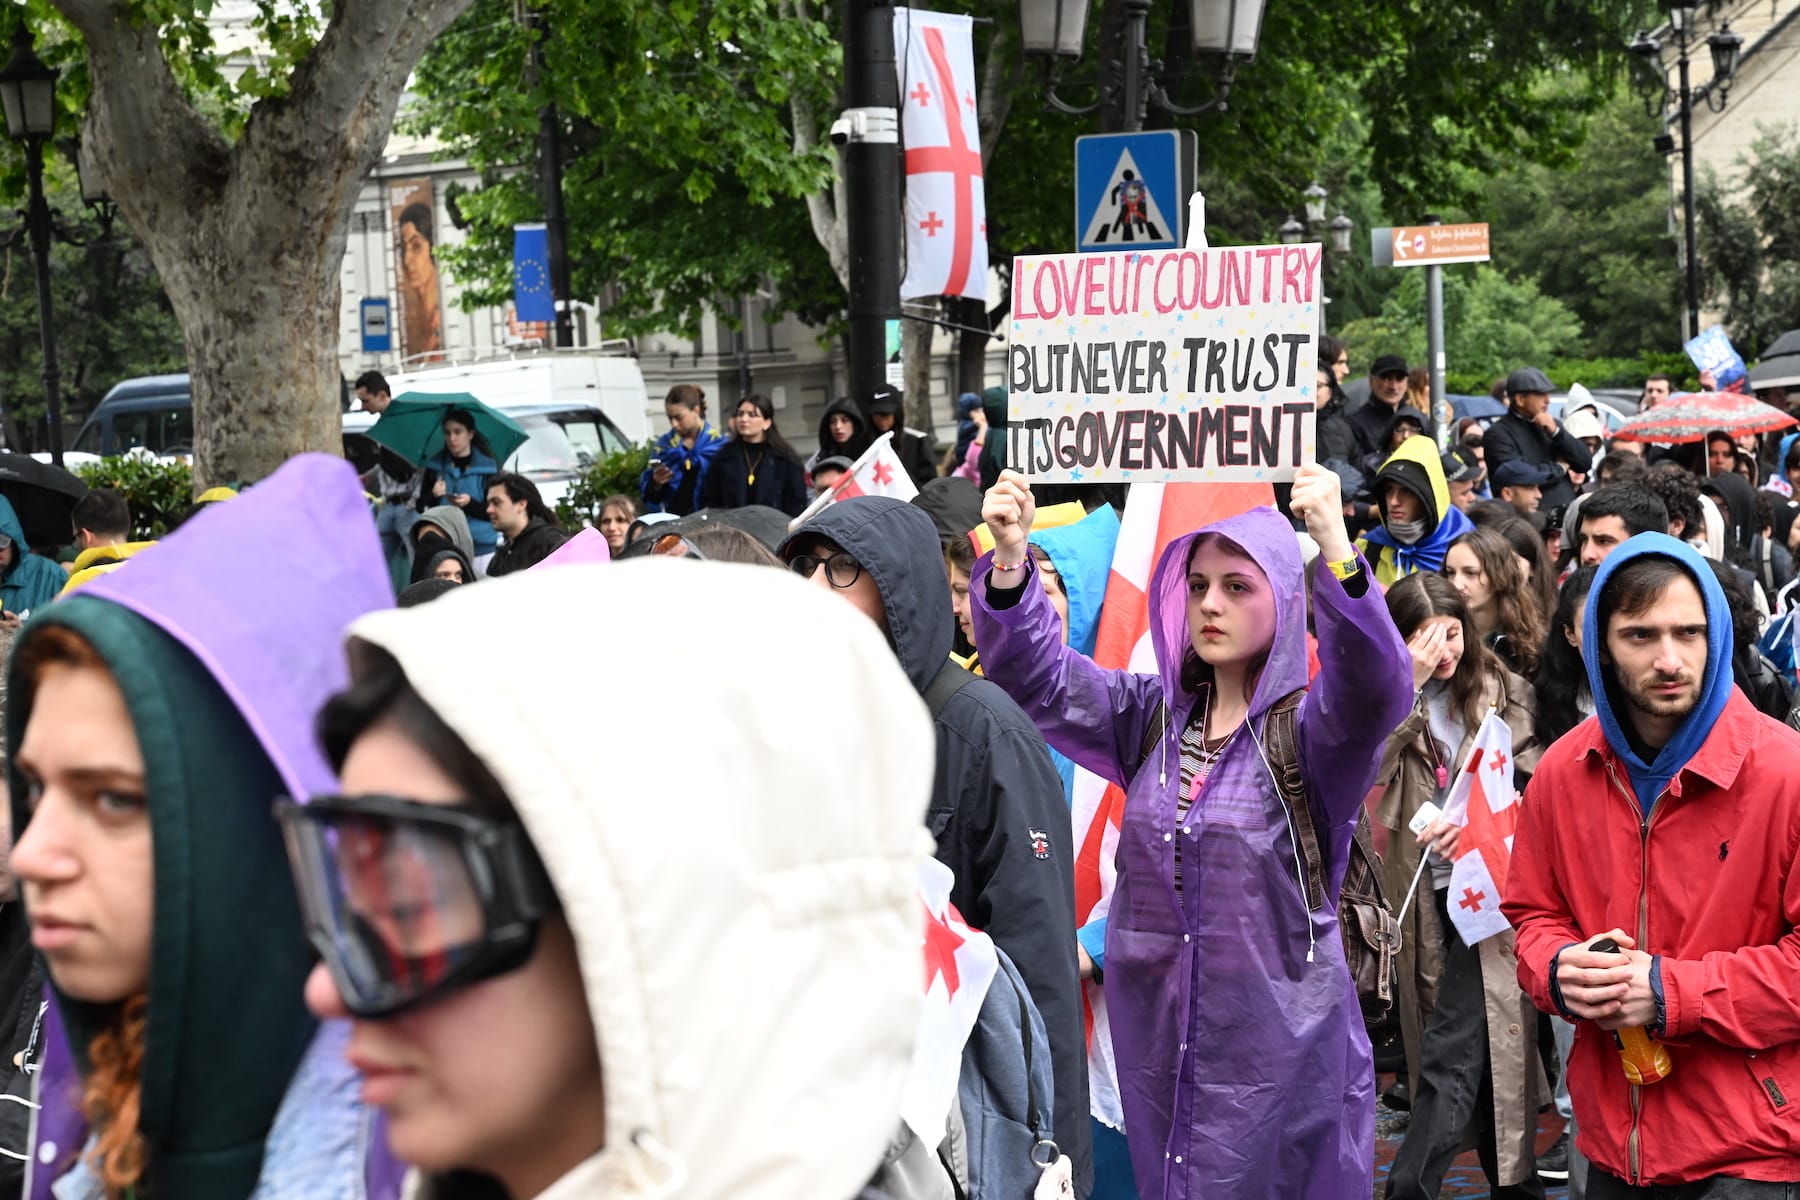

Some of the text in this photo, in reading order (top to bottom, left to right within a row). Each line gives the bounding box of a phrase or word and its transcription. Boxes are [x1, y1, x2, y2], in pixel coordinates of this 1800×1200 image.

[1013, 257, 1106, 320] LOVE
[1153, 247, 1322, 314] COUNTRY
[1009, 333, 1311, 394] BUT NEVER TRUST
[1007, 402, 1315, 475] ITS GOVERNMENT
